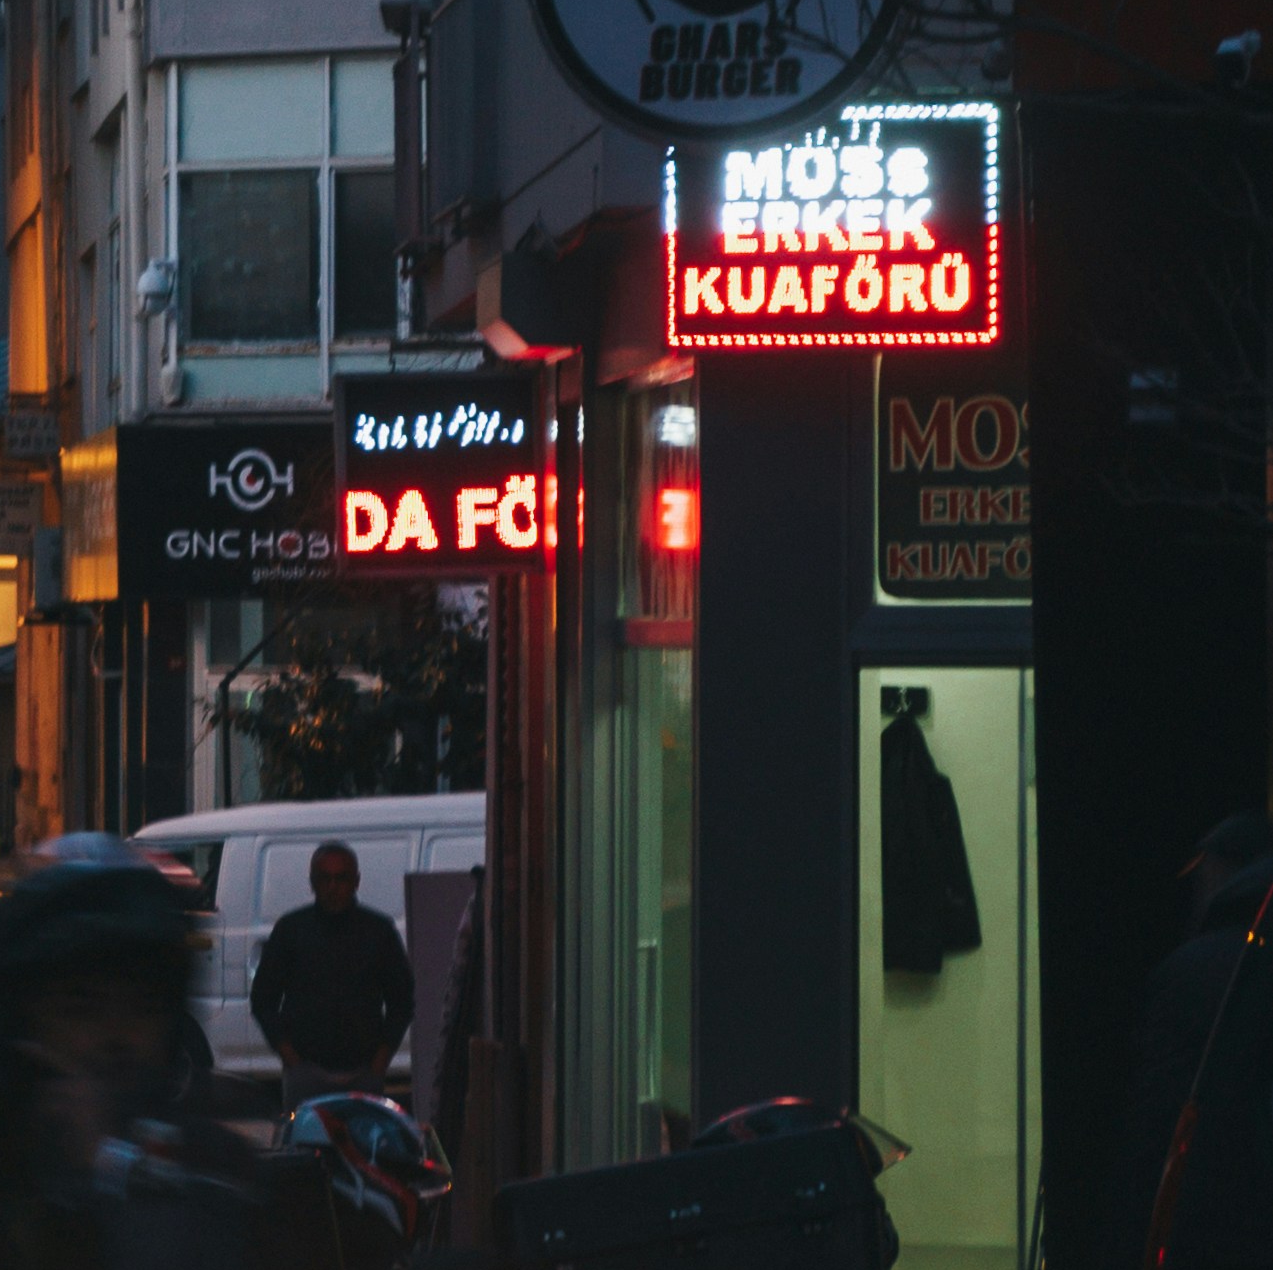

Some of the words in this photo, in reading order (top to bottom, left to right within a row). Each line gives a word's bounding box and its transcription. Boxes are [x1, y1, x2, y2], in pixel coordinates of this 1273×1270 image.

[640, 57, 802, 103] BURGER
[722, 198, 936, 254] ERKEK
[683, 252, 972, 315] KUAFÖRÜ
[889, 394, 1029, 472] MO
[165, 529, 241, 560] GNC
[346, 490, 439, 552] DA
